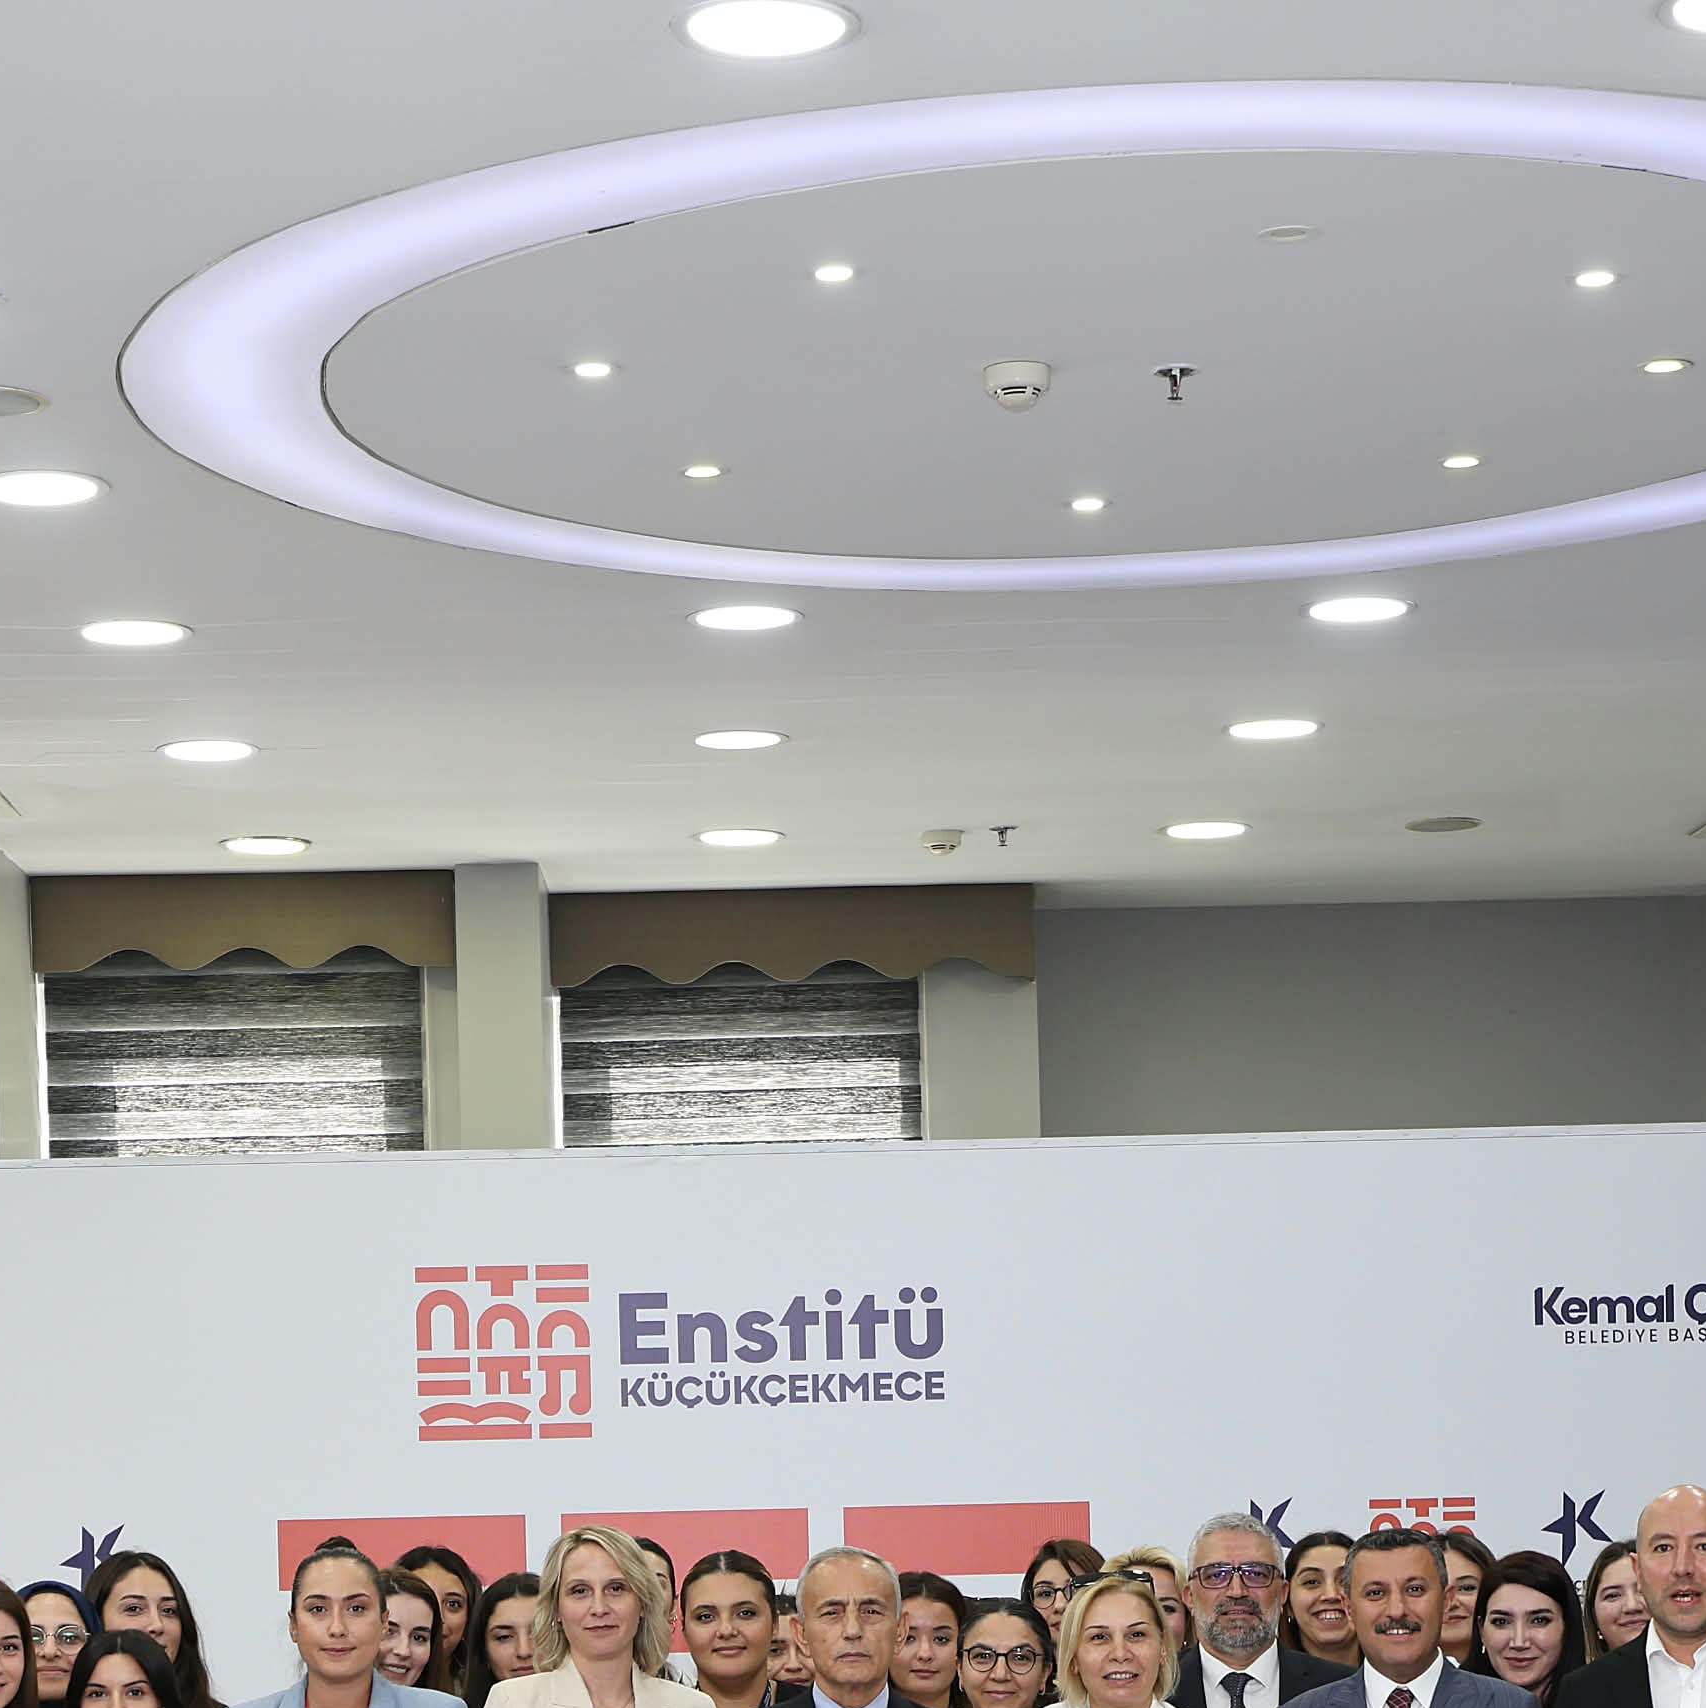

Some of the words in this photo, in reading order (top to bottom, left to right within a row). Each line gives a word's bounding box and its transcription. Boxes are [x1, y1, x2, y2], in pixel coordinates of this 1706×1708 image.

[1533, 1283, 1675, 1326] Kemal
[618, 1286, 944, 1365] Enstitü
[1564, 1327, 1658, 1345] BELEDİYE
[620, 1370, 945, 1409] KÜÇÜKÇEKMECE
